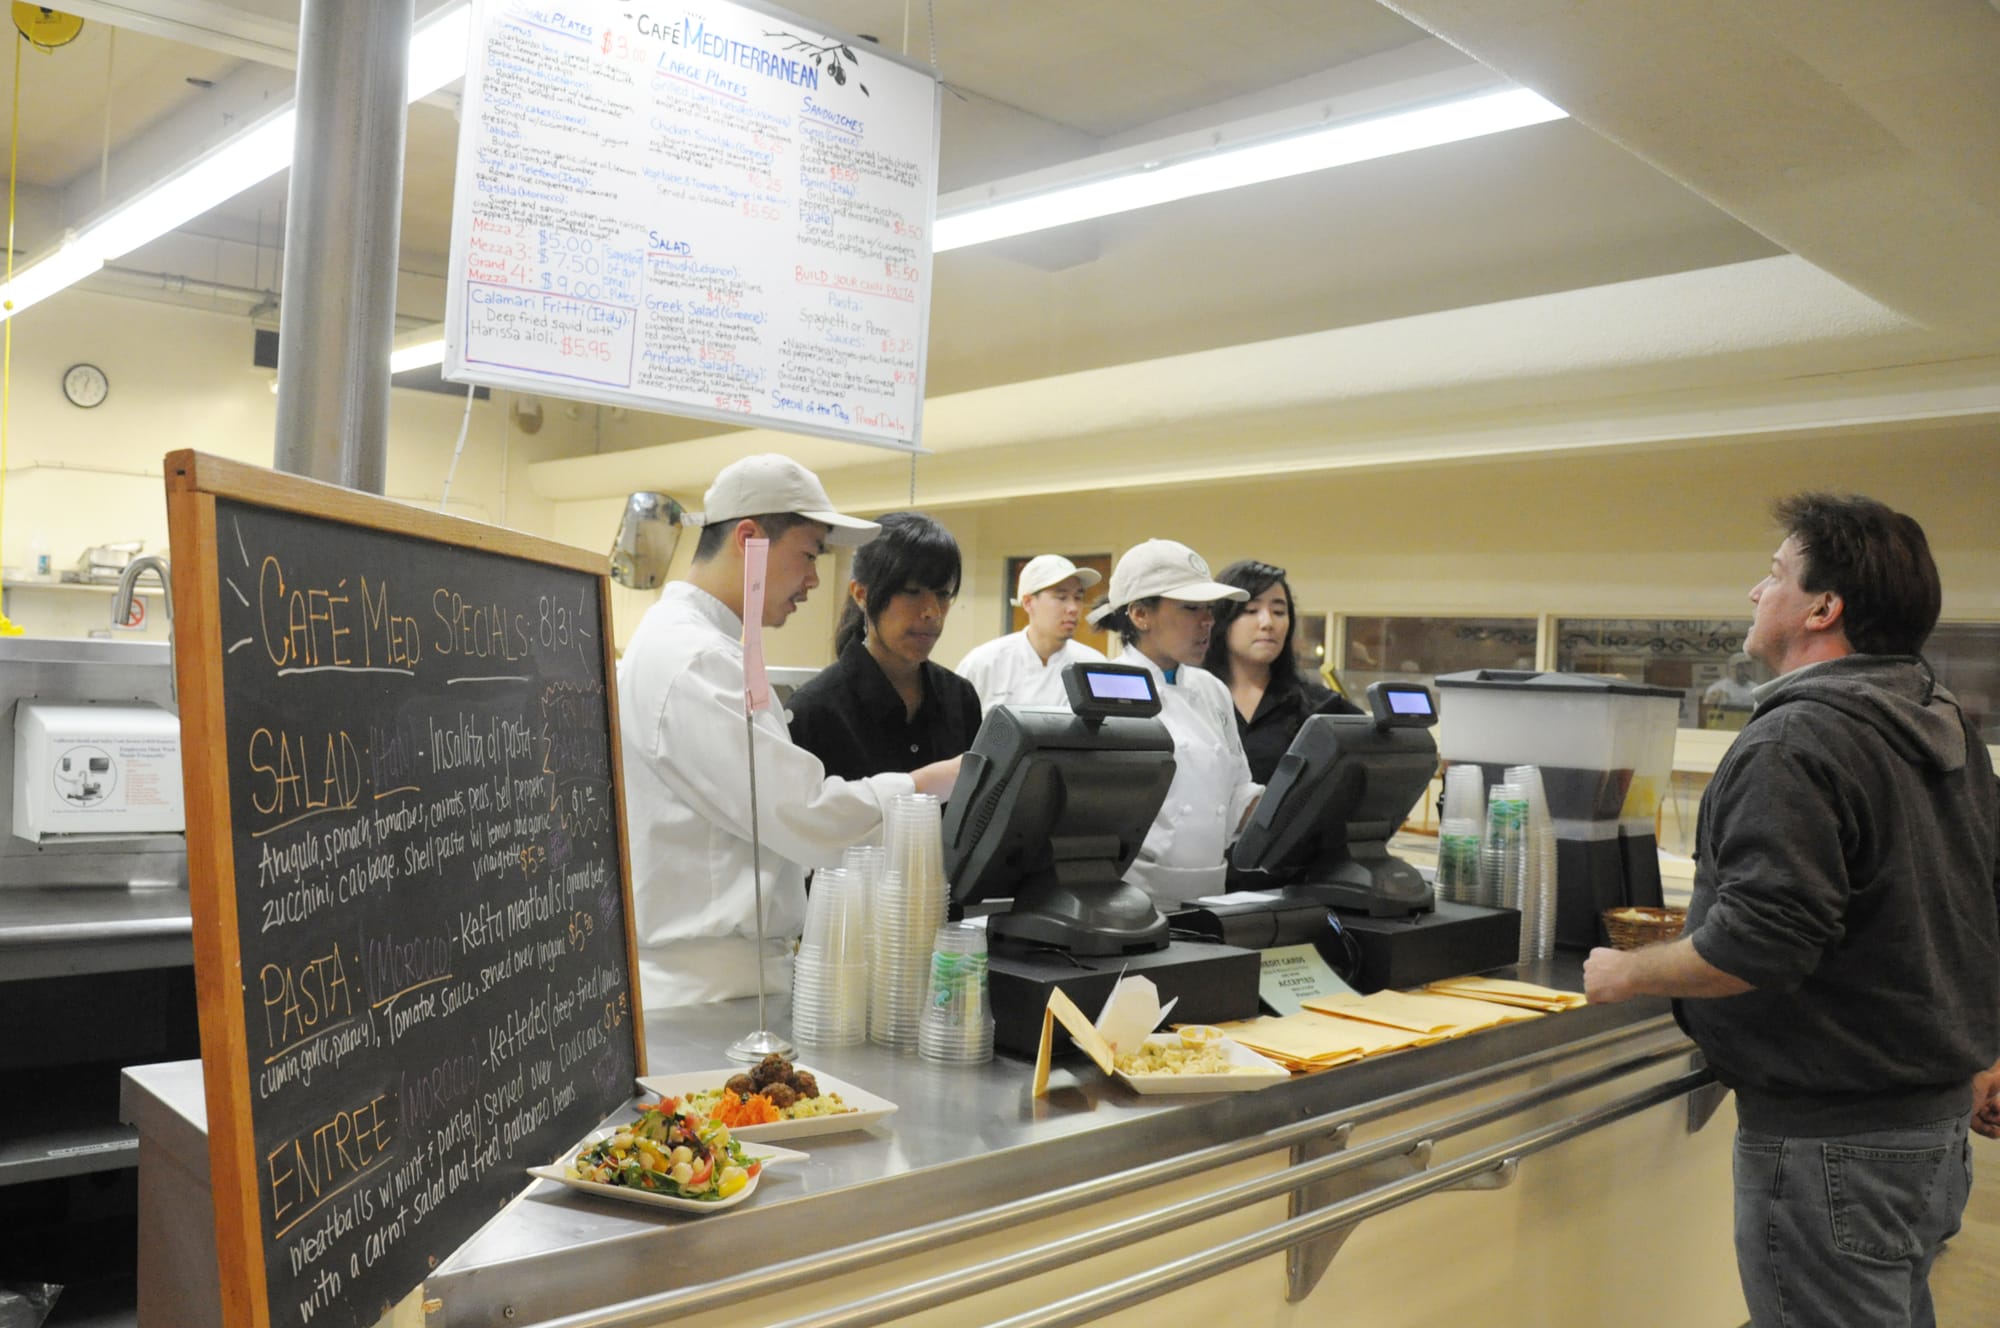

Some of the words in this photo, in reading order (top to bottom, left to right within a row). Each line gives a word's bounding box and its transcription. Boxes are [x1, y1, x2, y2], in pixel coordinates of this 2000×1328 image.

[551, 12, 593, 36] PLATES
[637, 14, 681, 45] CAFÉ
[682, 17, 819, 92] MEDITERRANEAN
[656, 51, 702, 80] LARGE
[704, 69, 749, 98] PLATES
[801, 96, 865, 134] SANDWICHES
[472, 217, 512, 237] Mezza
[537, 229, 594, 255] $5.00
[647, 231, 692, 256] SALAD
[468, 253, 507, 271] Grand
[469, 236, 513, 256] Mezza
[537, 247, 600, 277] $7.50
[794, 264, 829, 283] BUILD
[468, 267, 509, 285] Mezza
[539, 271, 602, 300] $9.00
[471, 287, 536, 310] Calamari
[645, 294, 683, 314] Greek
[687, 300, 720, 321] Salad
[486, 307, 517, 330] Deep
[518, 311, 549, 327] fried
[551, 317, 583, 334] squid
[471, 319, 521, 342] Harissa
[523, 325, 559, 346] aioli.
[560, 334, 612, 362] $5.95
[699, 358, 730, 375] Salad
[770, 388, 804, 412] Special
[259, 554, 352, 667] CAFÉ
[432, 587, 534, 661] SPECIALS:
[539, 594, 575, 653] 8/31
[249, 727, 371, 814] SALAD:
[467, 782, 494, 830] peas,
[493, 775, 512, 813] bell
[260, 874, 335, 934] zucchini,
[339, 853, 401, 904] cabbage,
[434, 829, 466, 877] pasta
[513, 942, 535, 975] over
[260, 941, 362, 1049] PASTA:
[394, 1144, 425, 1200] mint
[530, 1058, 553, 1091] over
[299, 1267, 342, 1324] with
[349, 1252, 361, 1279] a
[364, 1203, 409, 1269] carrot
[448, 1148, 470, 1195] and
[470, 1121, 501, 1183] fried
